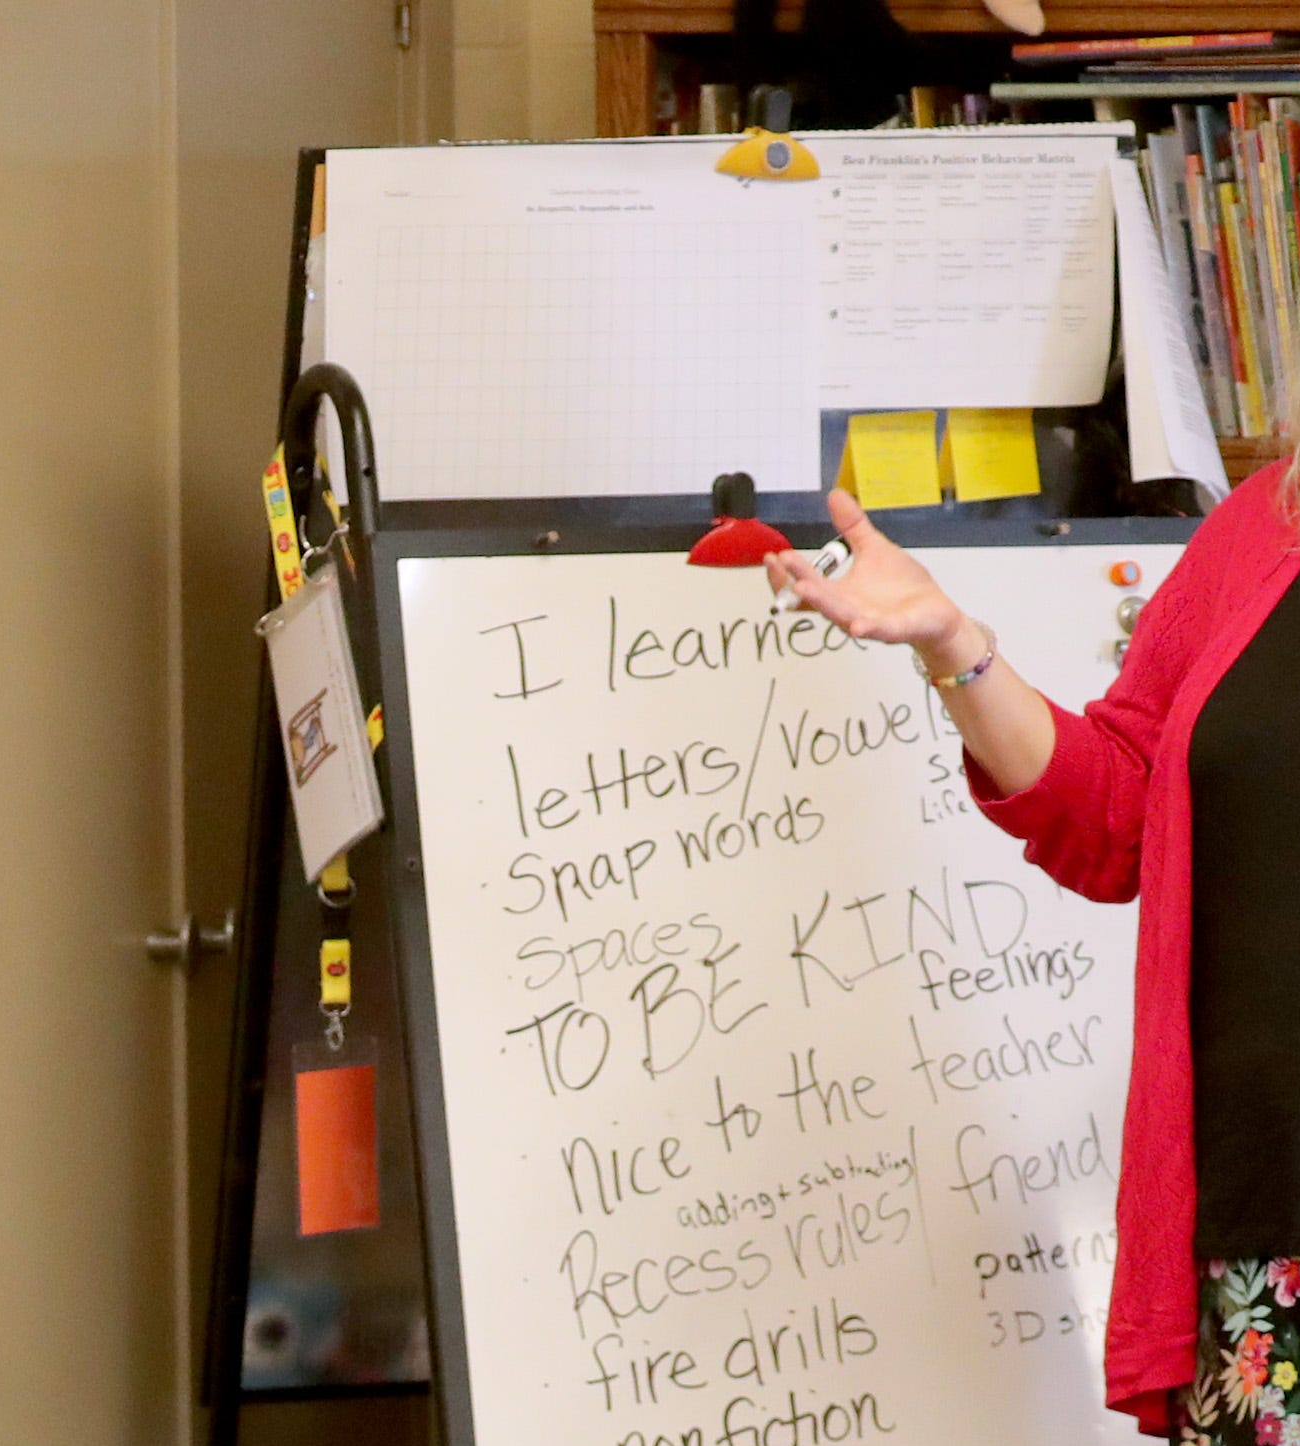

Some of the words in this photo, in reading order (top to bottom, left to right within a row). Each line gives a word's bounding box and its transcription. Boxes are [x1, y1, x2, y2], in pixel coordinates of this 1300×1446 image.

[480, 615, 563, 700] I
[507, 1001, 610, 1095] TO
[630, 942, 768, 1078] BE
[791, 867, 1027, 1007] KIND
[917, 940, 1094, 1011] feelings
[706, 1077, 761, 1151] to
[778, 1048, 886, 1132] the
[911, 1015, 1102, 1103] teacher
[560, 1230, 771, 1340] Recess
[587, 1333, 707, 1411] fire
[724, 1297, 878, 1387] drills
